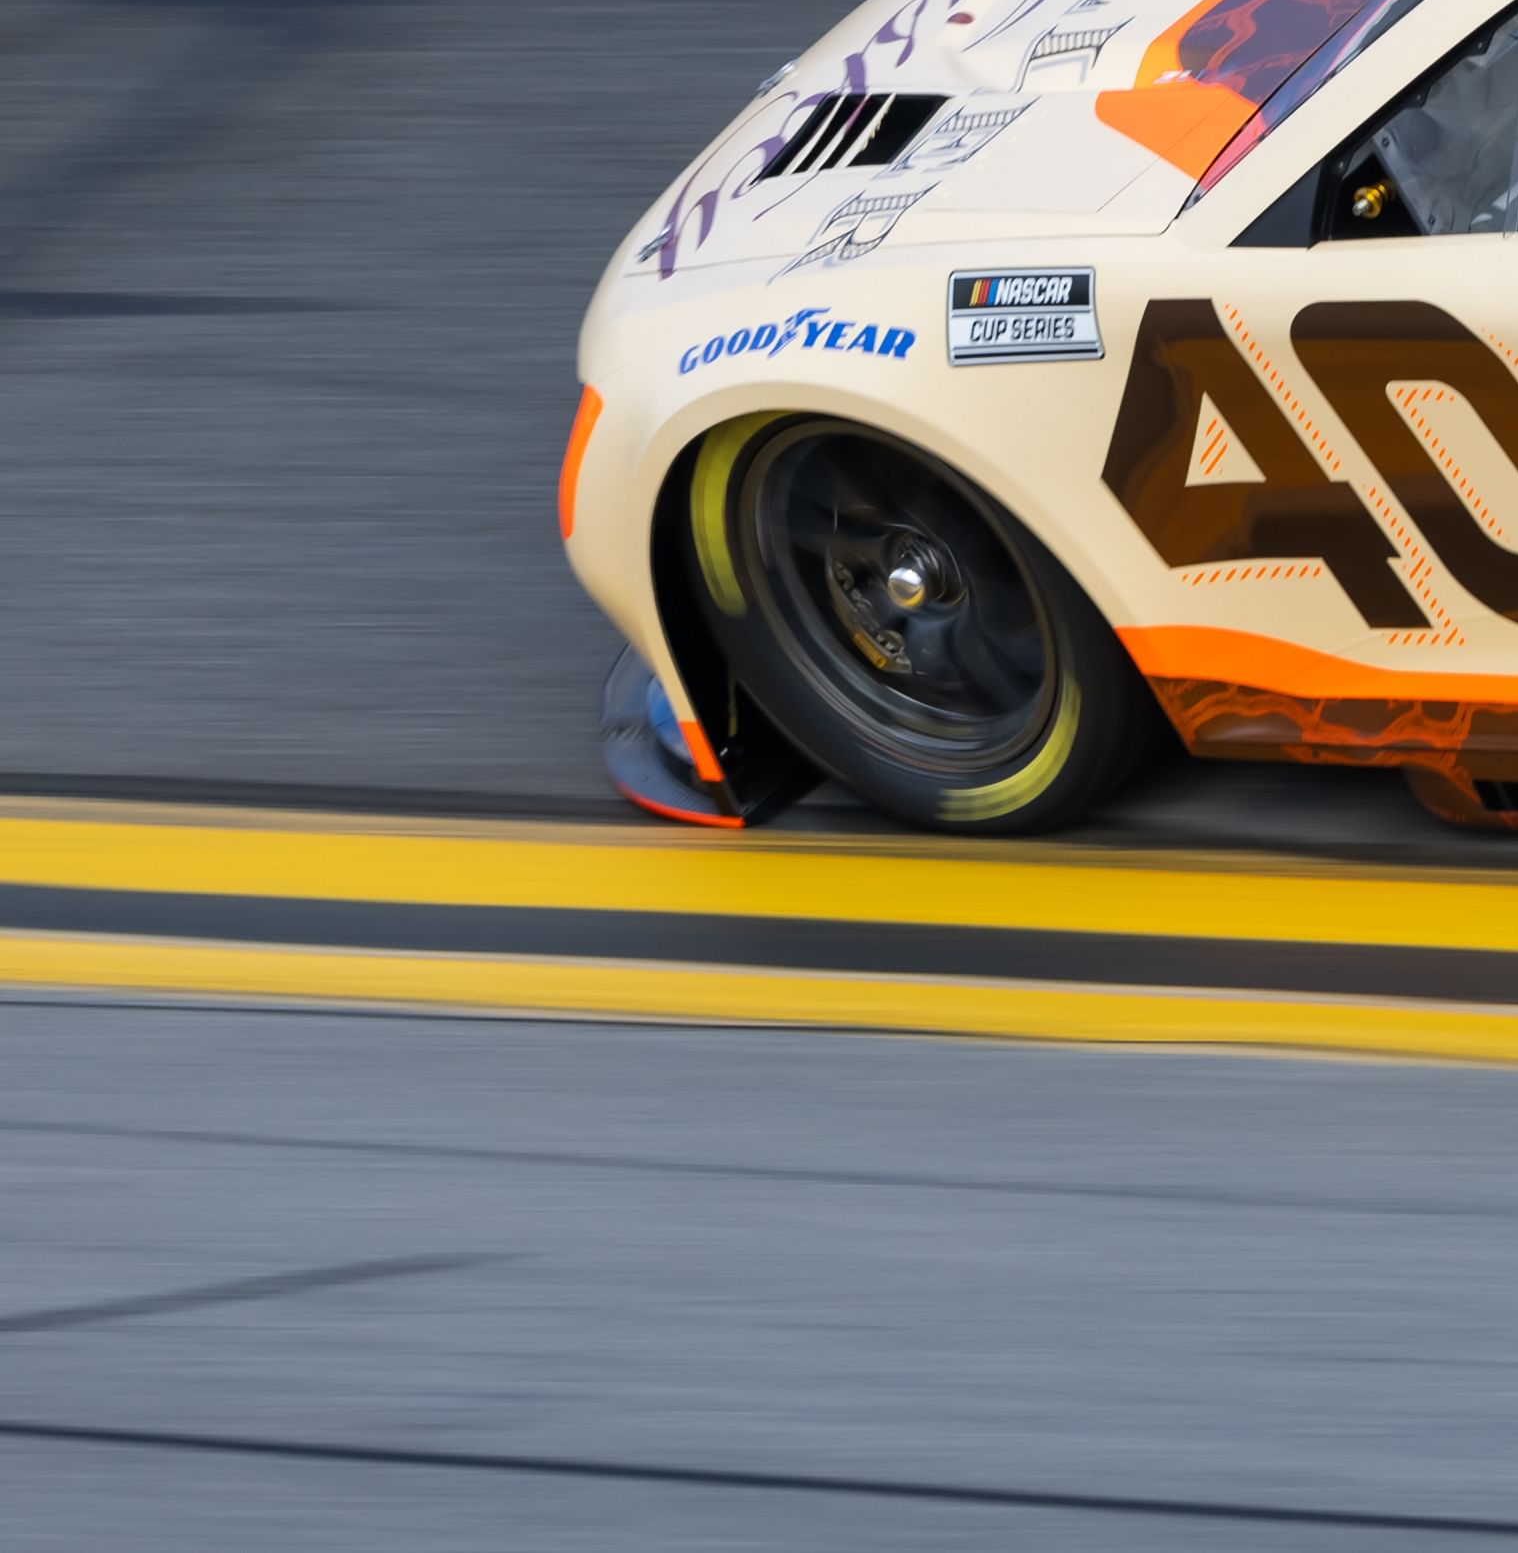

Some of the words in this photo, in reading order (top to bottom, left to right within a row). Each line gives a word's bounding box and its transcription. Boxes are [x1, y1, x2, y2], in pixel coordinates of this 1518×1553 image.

[994, 276, 1074, 306] NASCAR
[969, 317, 1007, 342] CUP
[1010, 315, 1076, 341] SERIES
